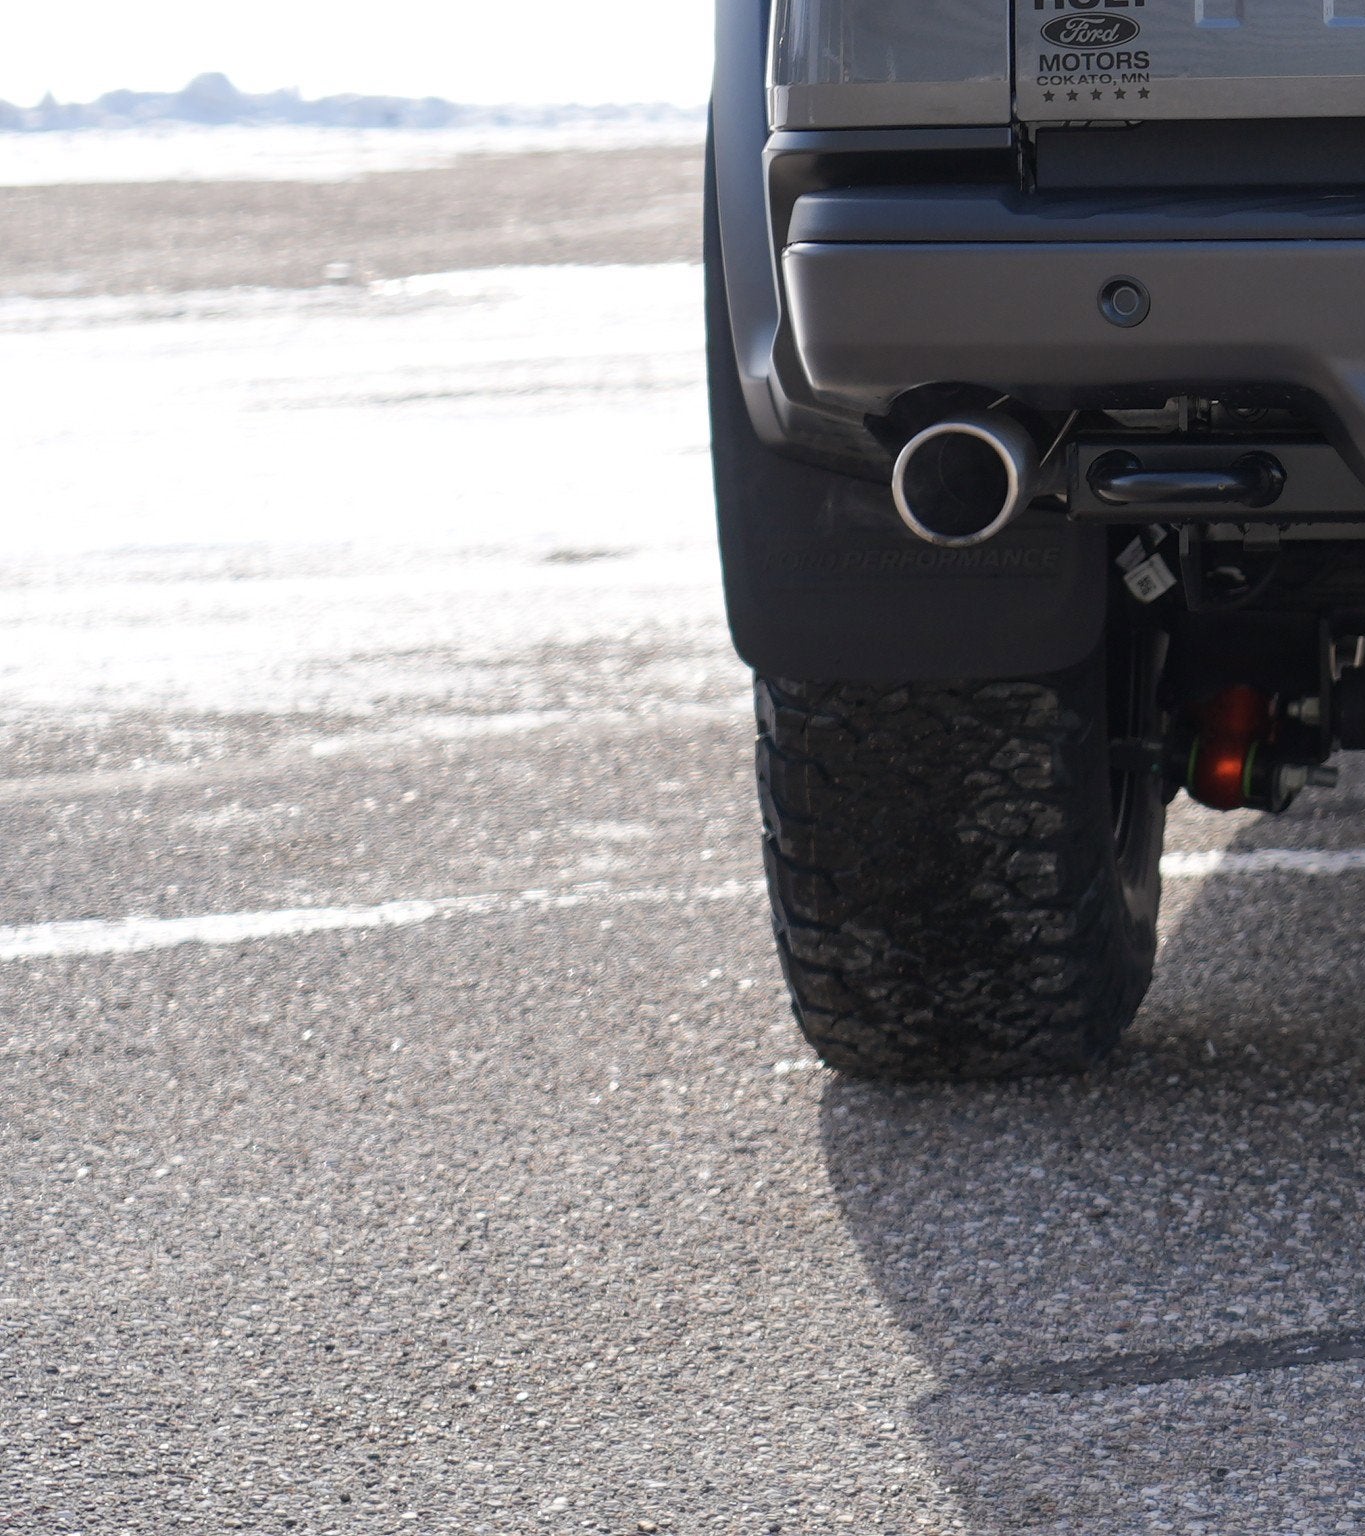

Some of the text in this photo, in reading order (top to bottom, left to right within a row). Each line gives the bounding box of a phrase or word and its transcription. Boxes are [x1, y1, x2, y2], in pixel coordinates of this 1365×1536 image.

[1060, 17, 1120, 43] Ford
[1039, 51, 1149, 72] MOTORS
[1037, 73, 1149, 86] COKATO, MN
[842, 545, 1060, 571] PERFORMANCE
